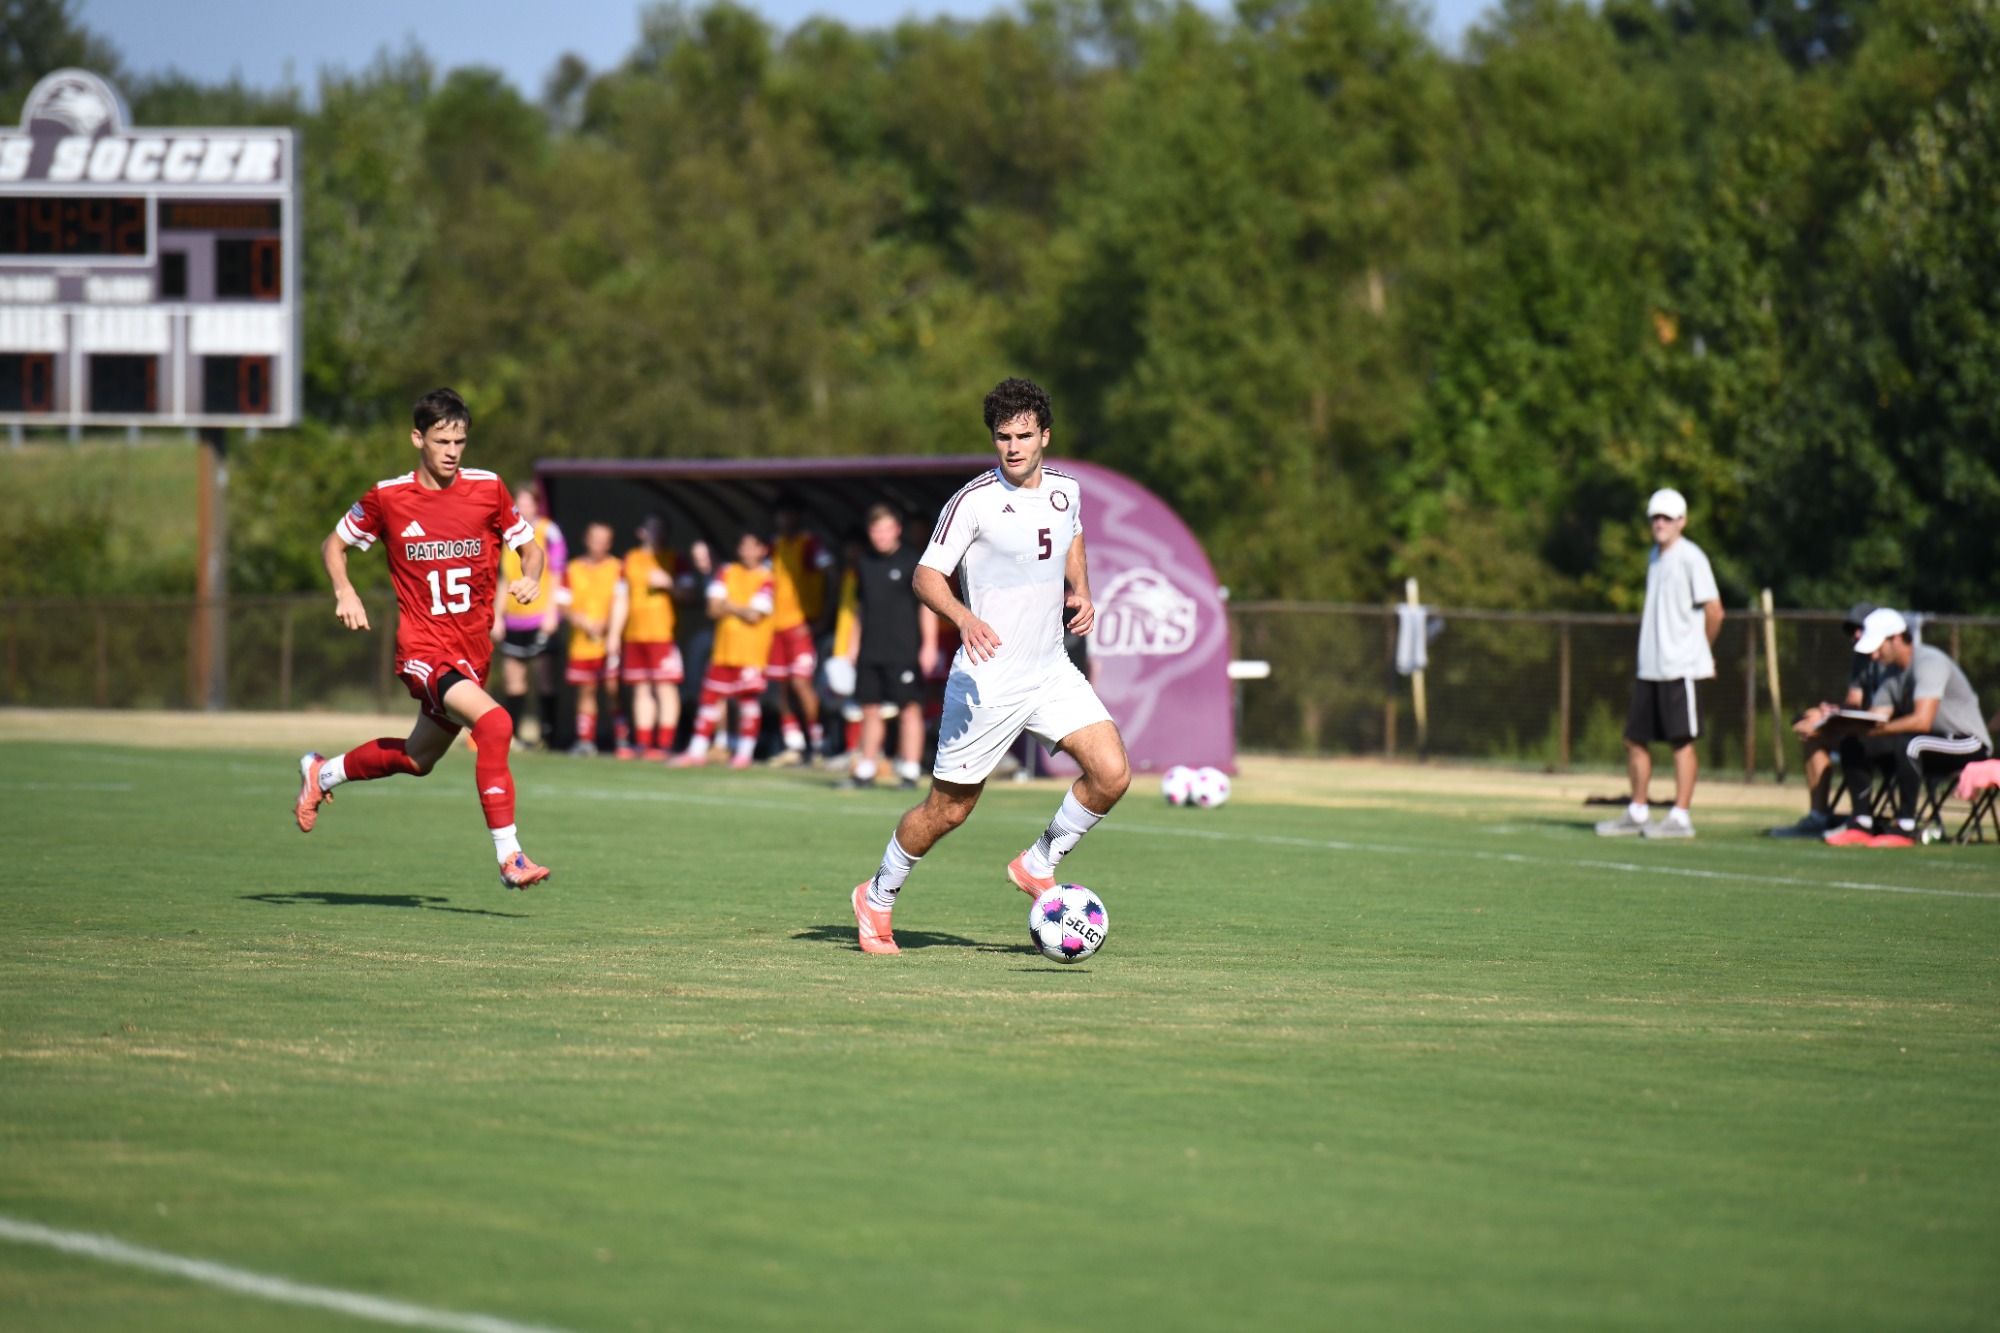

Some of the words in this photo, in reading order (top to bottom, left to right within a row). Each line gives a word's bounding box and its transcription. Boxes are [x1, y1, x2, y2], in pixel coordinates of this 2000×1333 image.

[46, 136, 280, 183] SOCCER
[405, 539, 482, 561] PATRIOTS
[1037, 527, 1053, 561] 5
[426, 567, 472, 616] 15
[1093, 604, 1191, 650] ONS
[1065, 916, 1102, 946] SELECT
